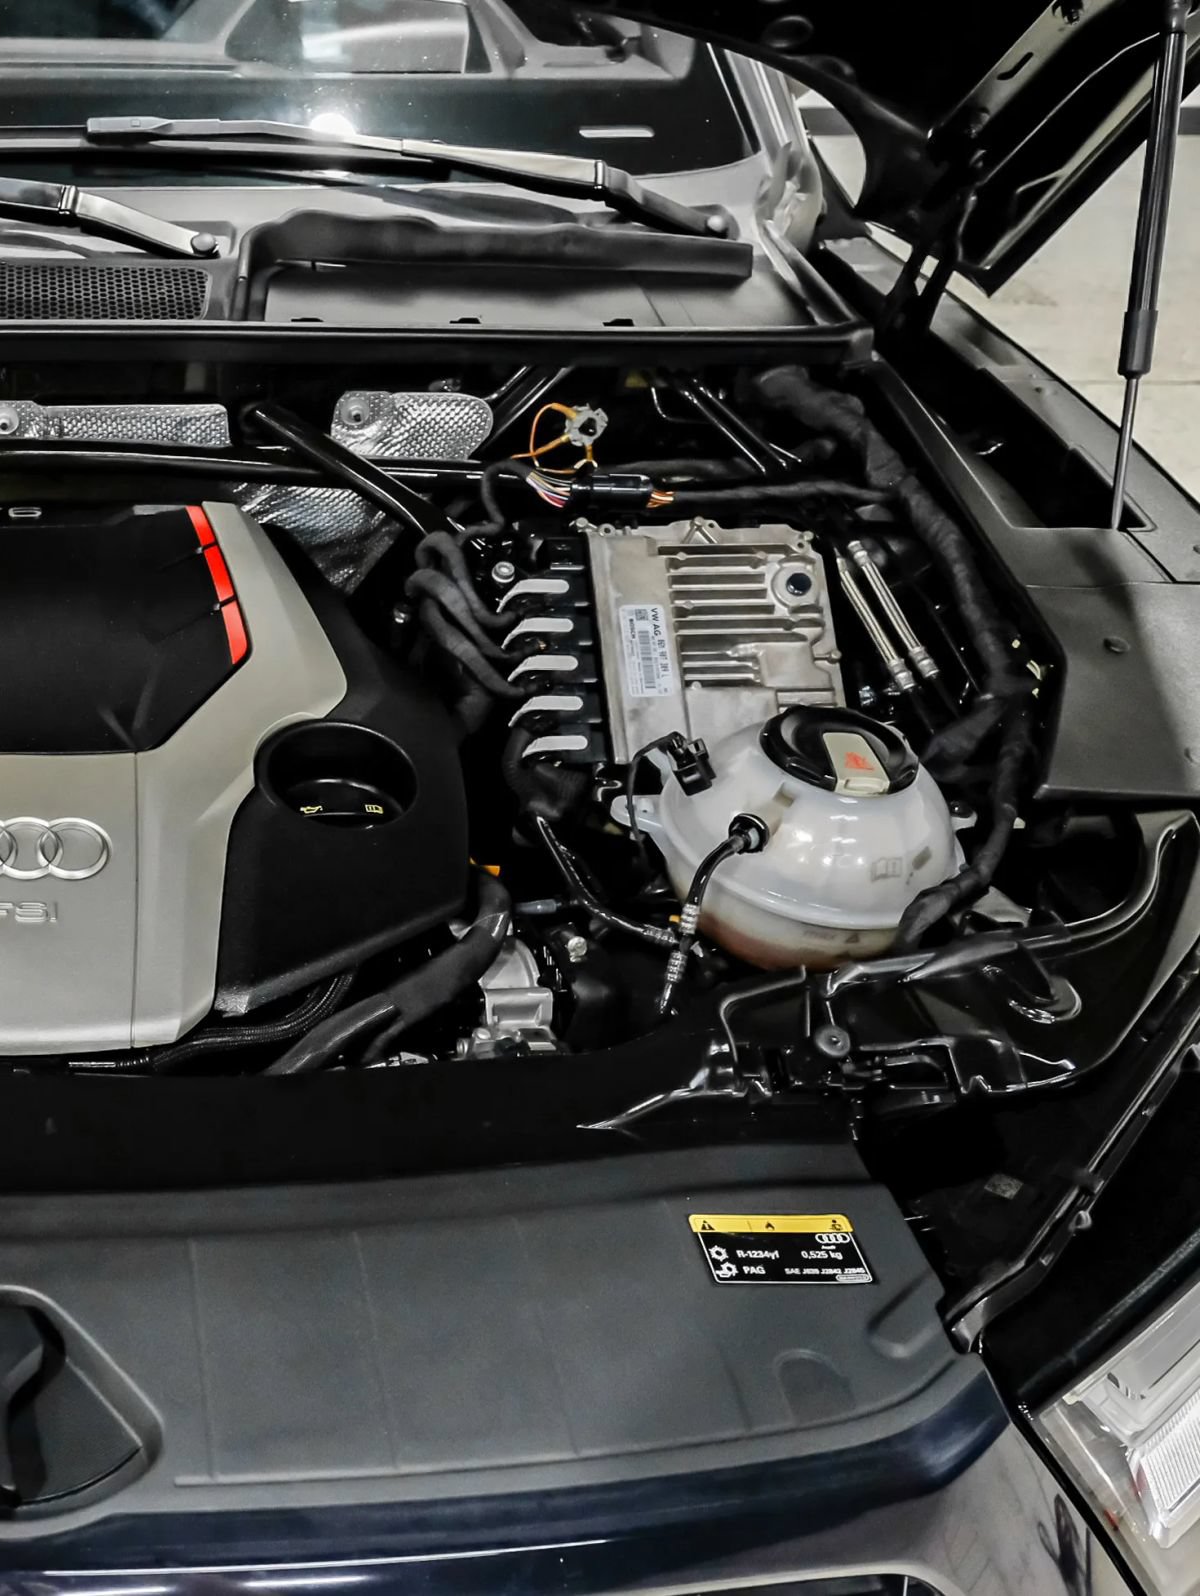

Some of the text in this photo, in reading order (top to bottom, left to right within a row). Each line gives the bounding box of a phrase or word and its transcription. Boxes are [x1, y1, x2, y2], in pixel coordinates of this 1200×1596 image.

[650, 607, 660, 622] VW
[653, 623, 662, 636] AG
[801, 1250, 843, 1260] 0,525 kg
[742, 1266, 766, 1275] PAG
